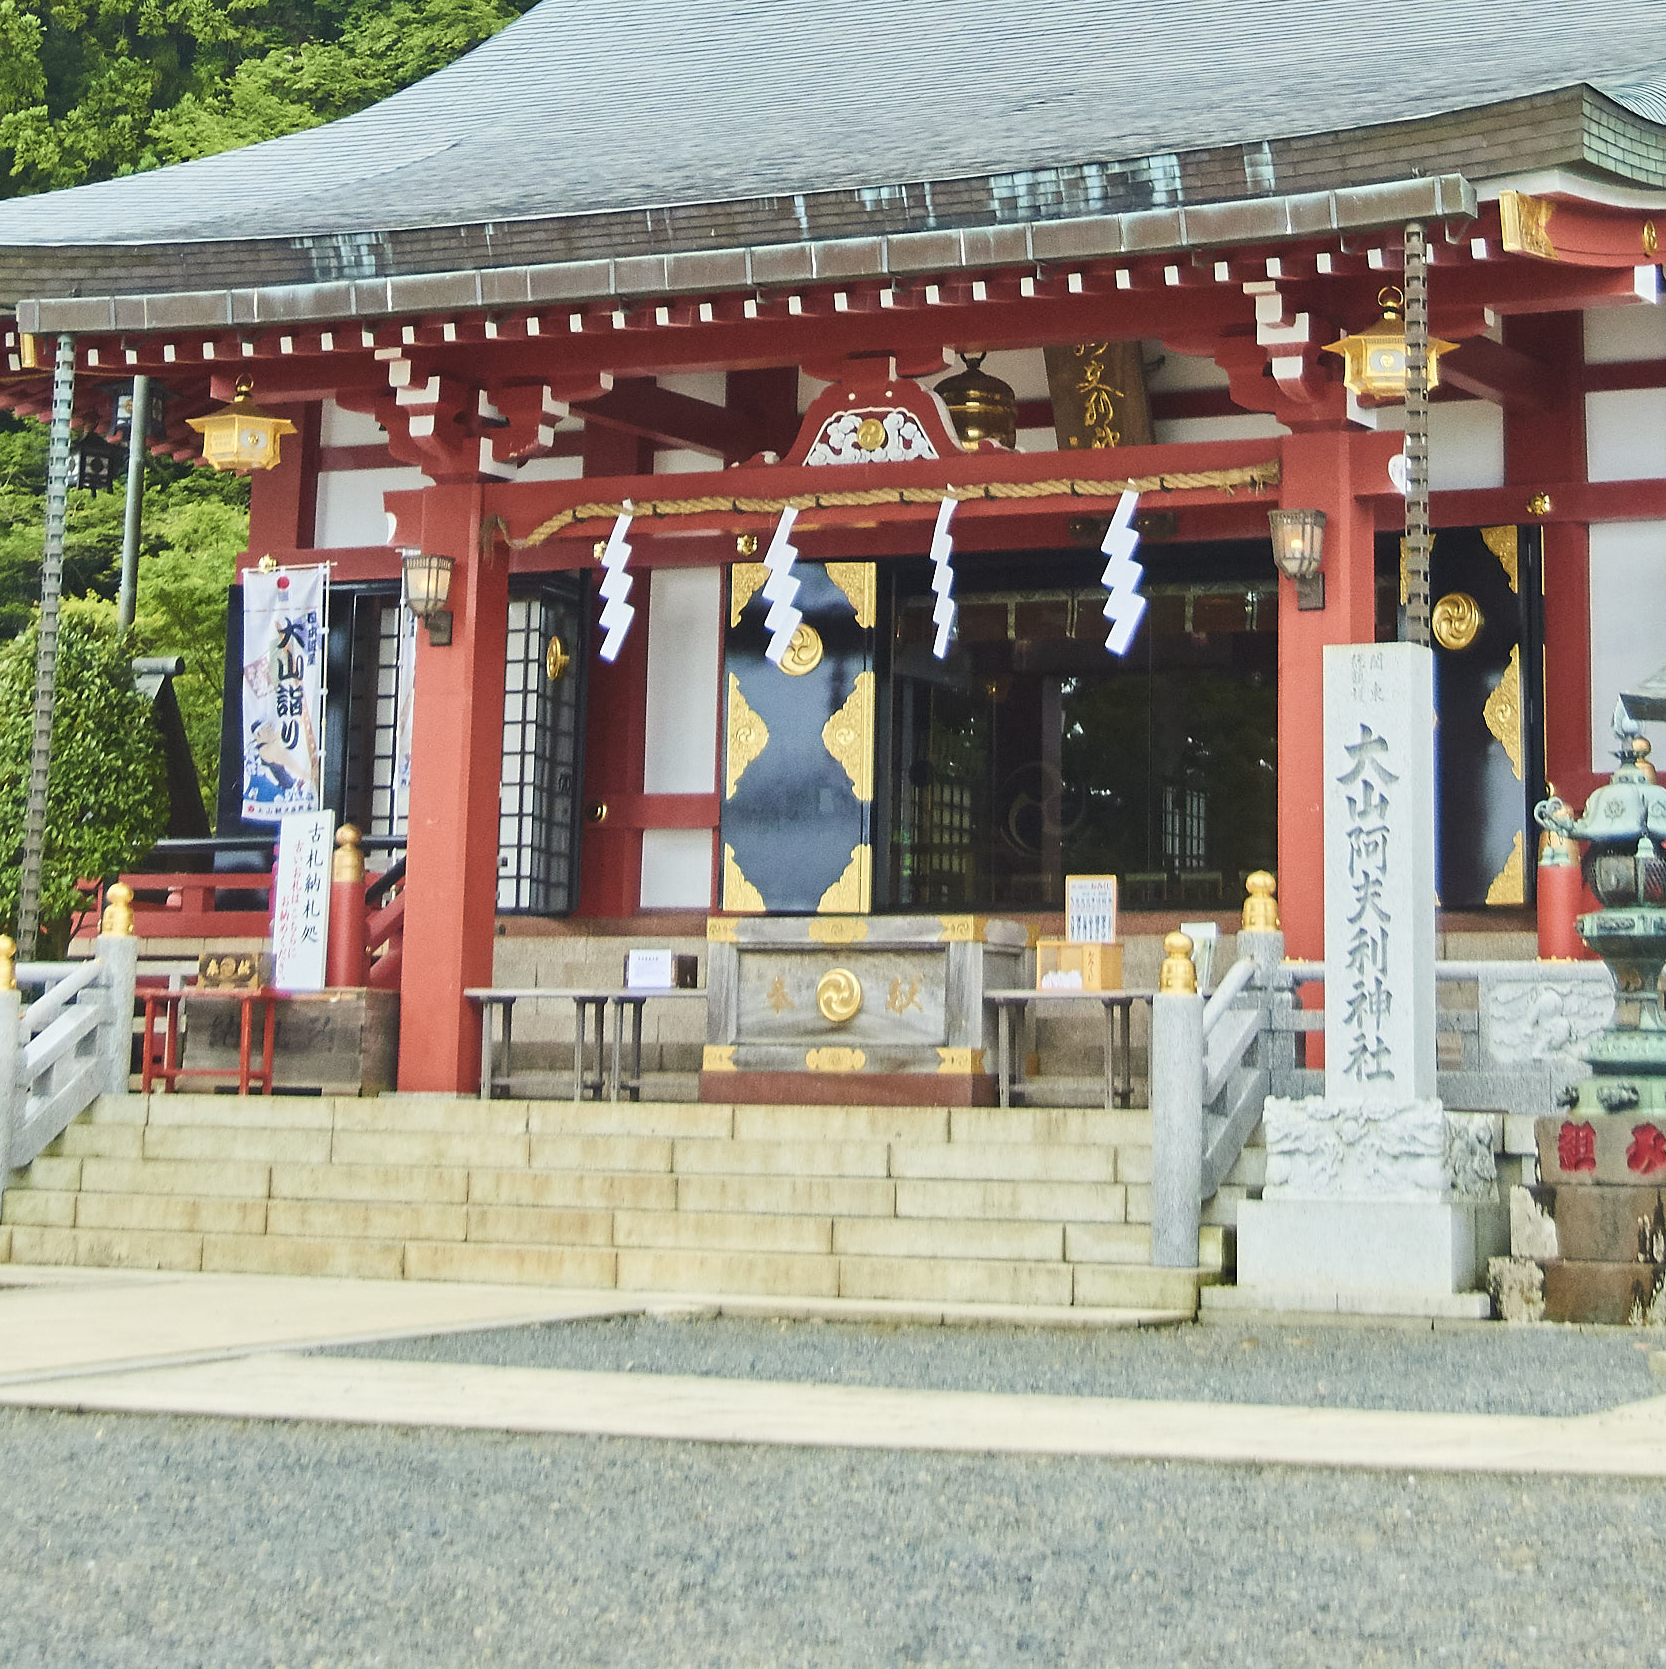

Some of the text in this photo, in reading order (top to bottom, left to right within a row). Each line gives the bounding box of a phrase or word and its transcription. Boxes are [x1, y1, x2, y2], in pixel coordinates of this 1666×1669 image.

[276, 617, 305, 750] 大山詣り
[301, 822, 325, 943] 古札納札処
[1336, 722, 1400, 1082] 大山阿夫利神社
